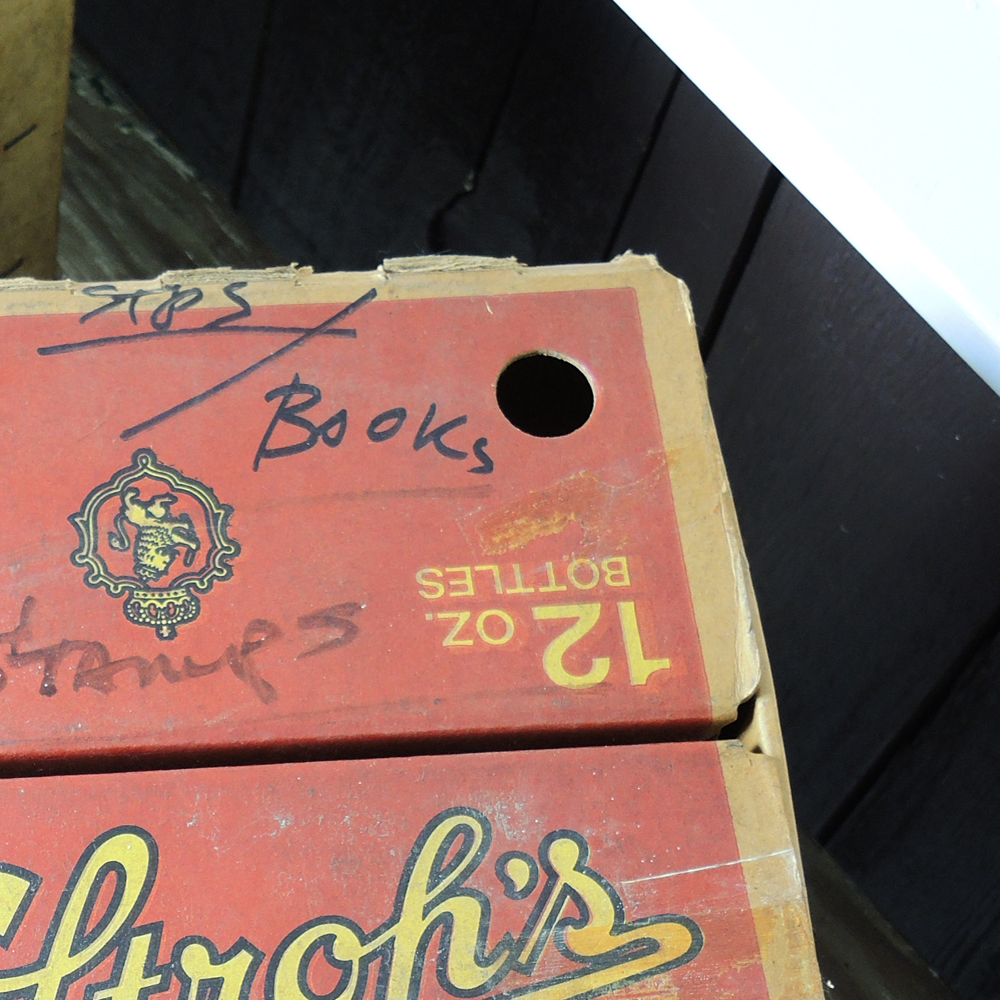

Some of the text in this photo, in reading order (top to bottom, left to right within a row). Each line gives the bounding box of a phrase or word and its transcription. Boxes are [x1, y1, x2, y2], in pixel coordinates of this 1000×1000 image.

[415, 555, 632, 600] BOTTLES
[424, 600, 672, 690] 12 OZ.
